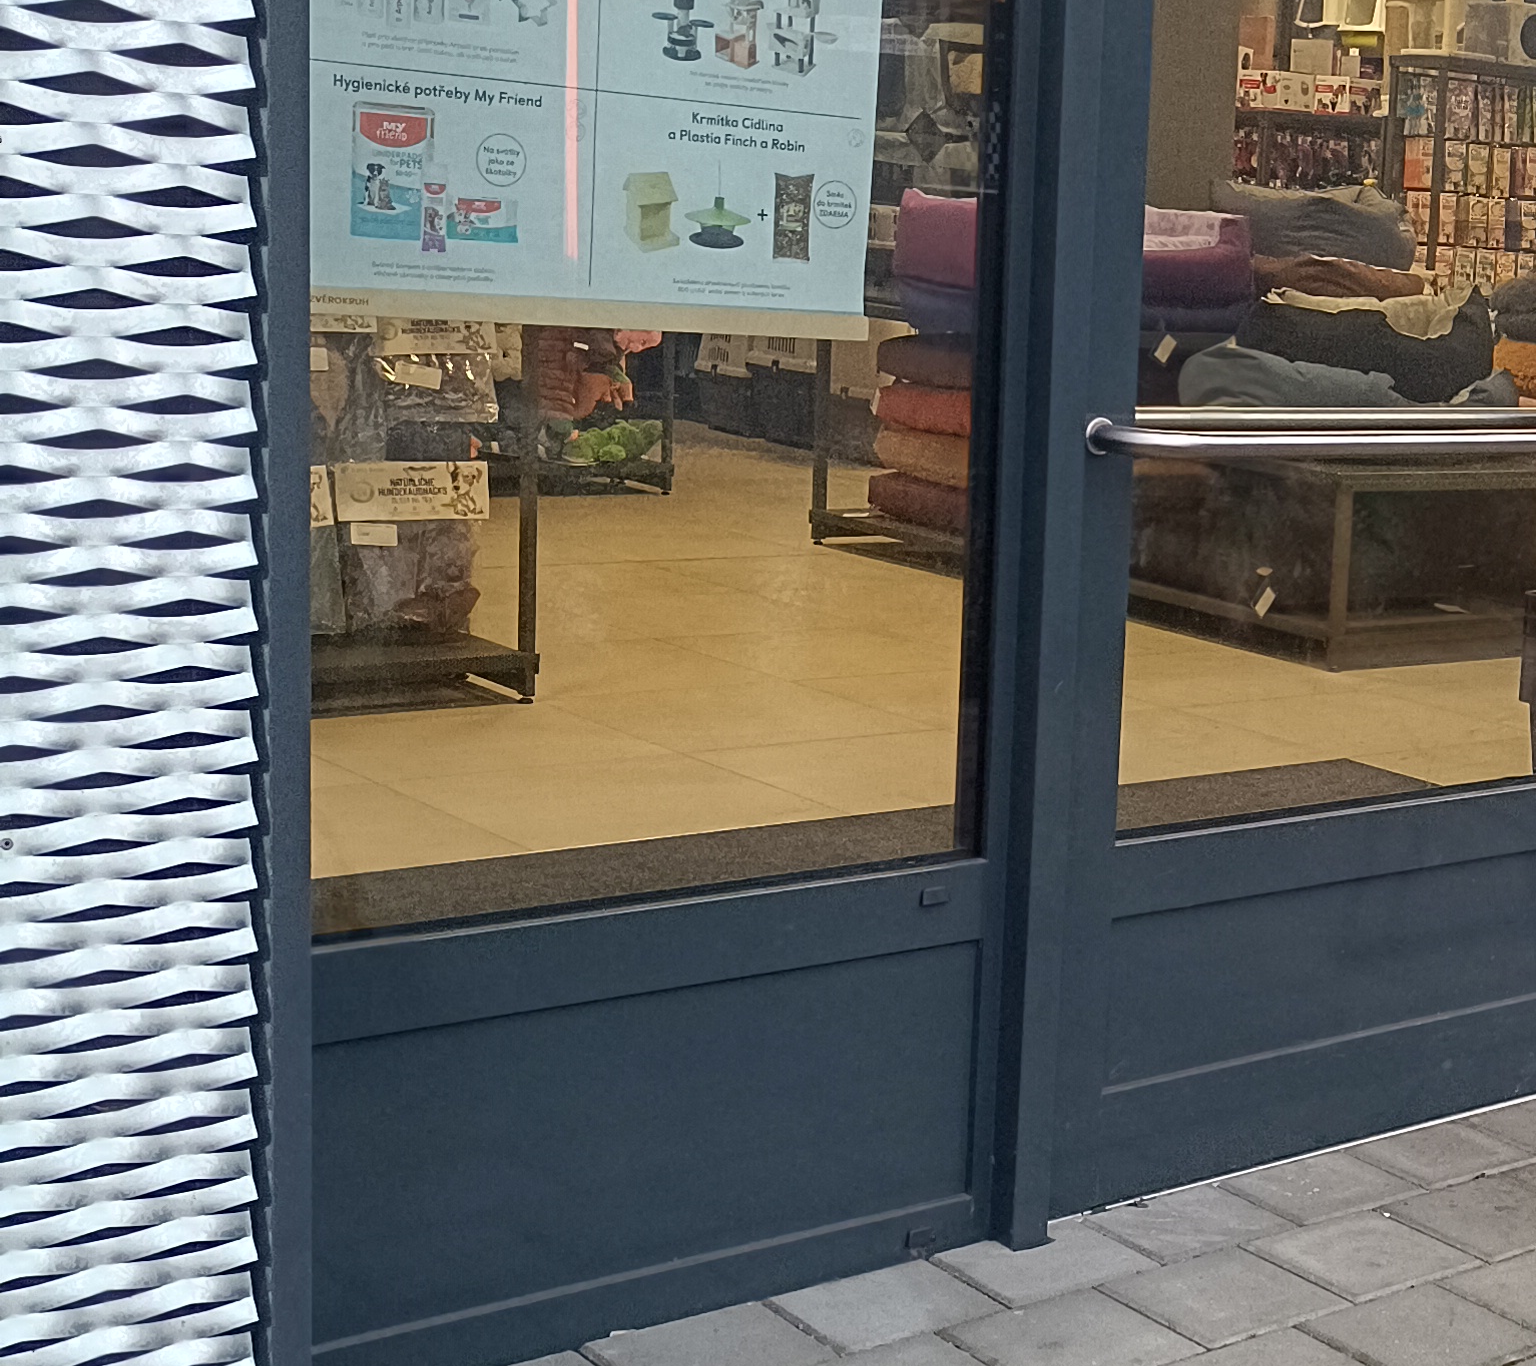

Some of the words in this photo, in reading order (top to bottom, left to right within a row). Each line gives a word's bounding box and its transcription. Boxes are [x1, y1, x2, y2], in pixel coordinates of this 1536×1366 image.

[332, 73, 411, 94] Hygienické
[414, 82, 471, 104] potřeby
[474, 88, 495, 107] My
[498, 91, 543, 109] Friend
[691, 111, 740, 129] Krmítka
[667, 130, 676, 141] a
[679, 129, 722, 146] Plastia
[724, 133, 758, 149] Finch
[760, 138, 769, 150] a
[771, 138, 806, 153] Robin
